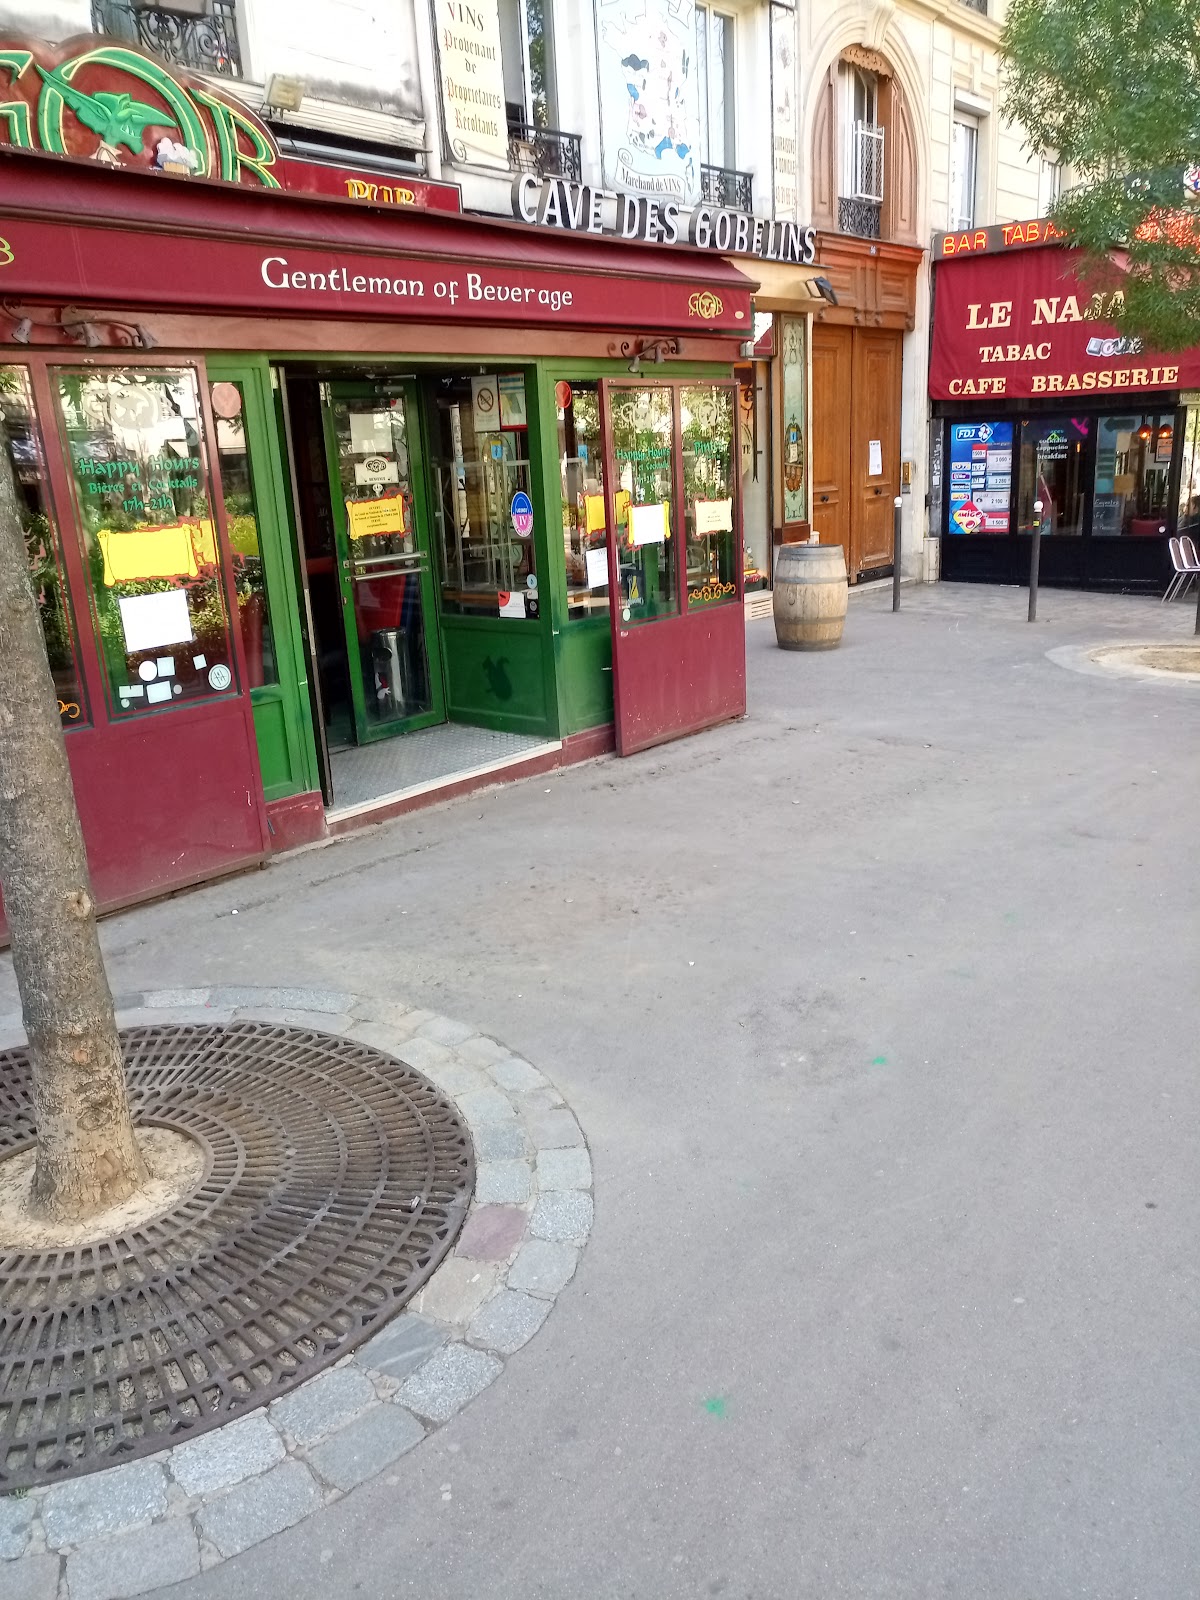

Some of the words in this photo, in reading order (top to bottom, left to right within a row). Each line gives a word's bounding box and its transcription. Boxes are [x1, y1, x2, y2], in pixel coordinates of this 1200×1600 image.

[447, 2, 484, 32] VINS
[444, 28, 496, 61] Provenant
[465, 58, 477, 74] de
[621, 167, 654, 191] Marchand
[656, 178, 663, 191] de
[664, 178, 681, 193] VINS
[515, 173, 603, 234] CAVE
[618, 194, 679, 245] DES
[692, 208, 817, 264] GOBELINS
[942, 231, 987, 255] BAR
[260, 256, 425, 297] Gentleman
[434, 280, 459, 305] of
[466, 272, 573, 311] Beverage
[965, 300, 1013, 330] LE
[979, 342, 1052, 363] TABAC
[949, 377, 1006, 396] CAFE
[1031, 366, 1179, 393] BRASSERIE
[958, 429, 975, 438] FDJ
[79, 458, 140, 478] Happy
[149, 454, 199, 471] Hours
[1037, 452, 1068, 460] breakfast
[149, 475, 198, 491] Cocktails
[519, 515, 528, 526] IV
